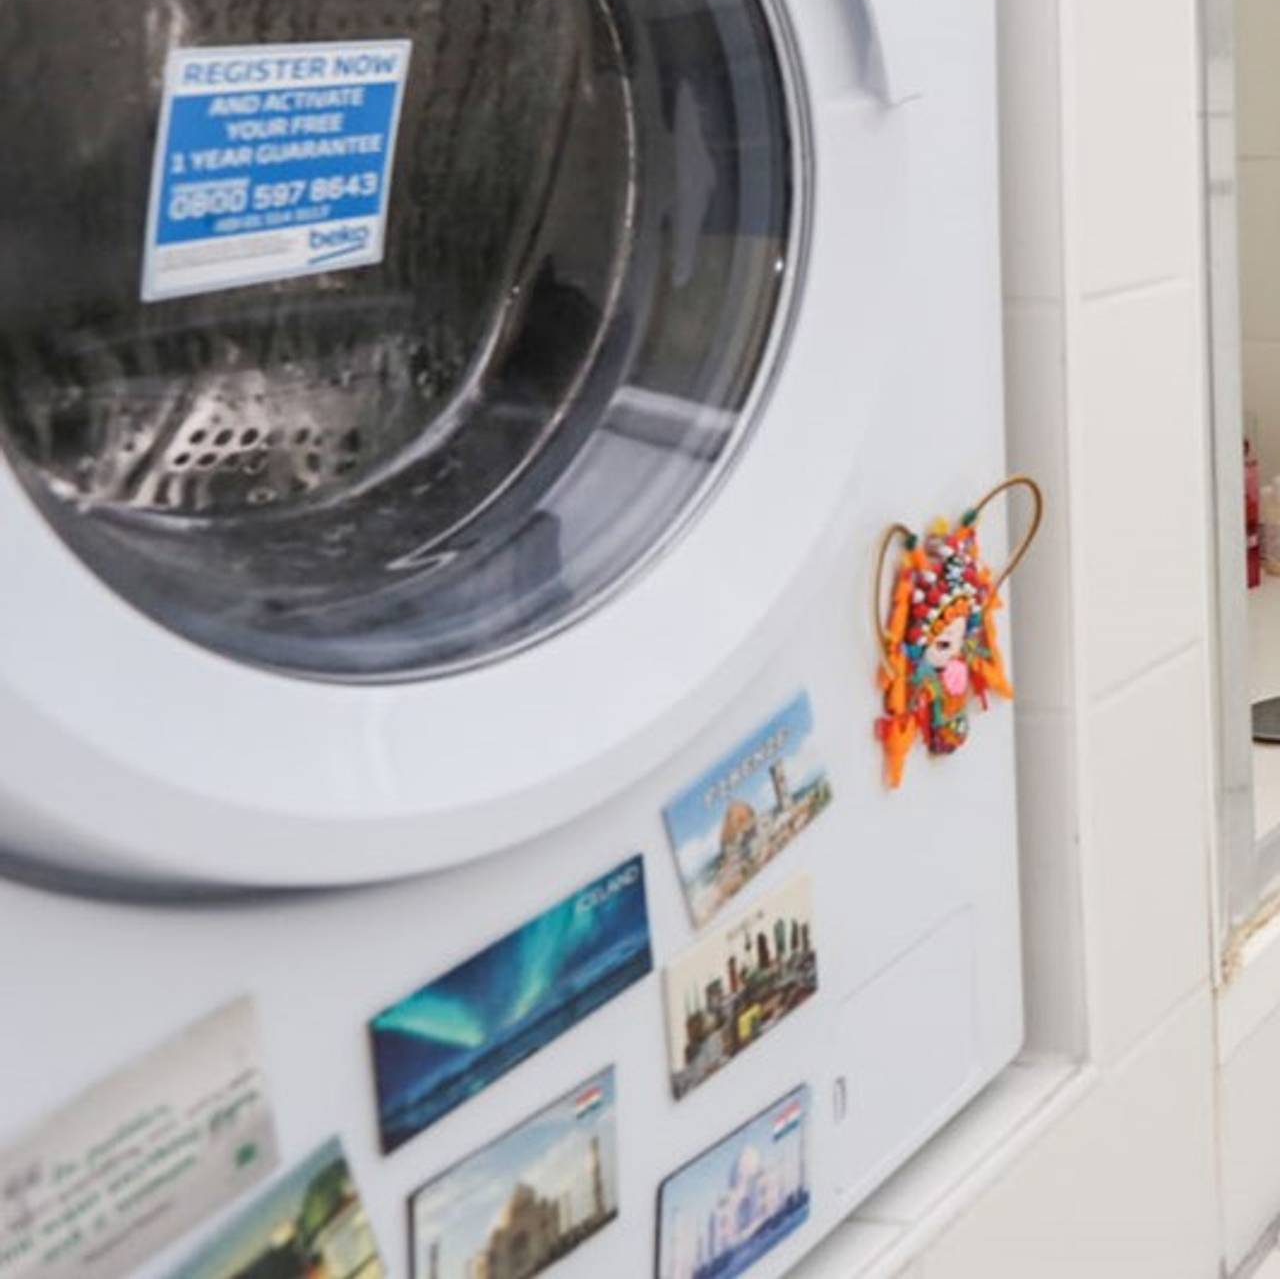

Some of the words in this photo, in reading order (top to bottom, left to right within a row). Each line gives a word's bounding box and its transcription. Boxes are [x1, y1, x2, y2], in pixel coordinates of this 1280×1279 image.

[184, 58, 326, 83] REGISTER
[335, 54, 394, 75] NOW
[210, 96, 260, 115] AND
[265, 88, 363, 111] ACTIVATE
[228, 118, 288, 139] YOUR
[292, 114, 342, 133] FREE
[170, 152, 184, 174] 1
[192, 148, 251, 170] YEAR
[256, 135, 381, 164] GUARANTEE
[168, 188, 247, 220] 0800
[308, 227, 370, 249] beko
